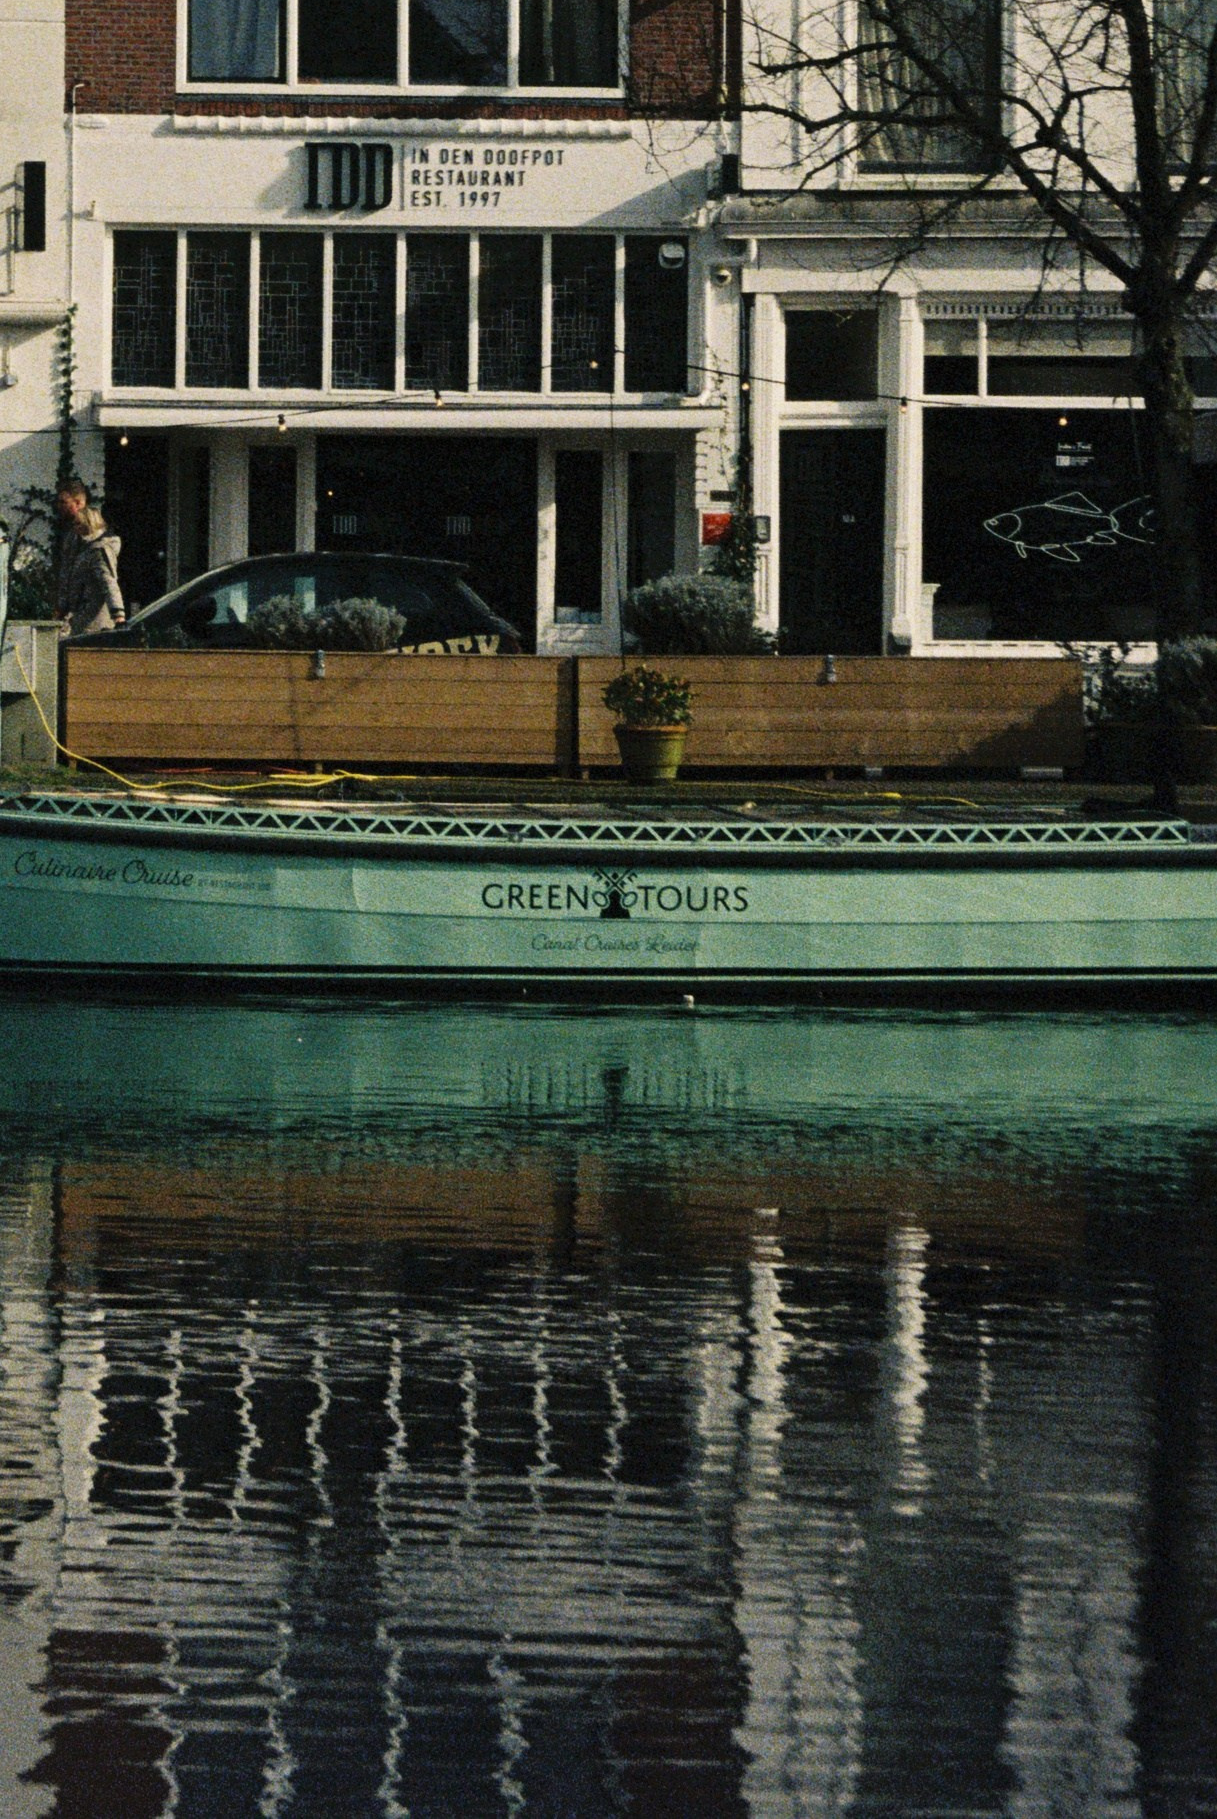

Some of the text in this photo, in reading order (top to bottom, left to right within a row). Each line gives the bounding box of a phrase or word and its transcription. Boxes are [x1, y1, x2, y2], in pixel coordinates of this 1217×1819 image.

[411, 148, 565, 166] IN DEN DOOFPOT
[411, 169, 526, 186] RESTAURANT
[410, 191, 501, 208] EST. 1997
[14, 850, 117, 881] Culinaire
[122, 857, 194, 887] Cruise
[481, 883, 749, 912] GREEN TOURS
